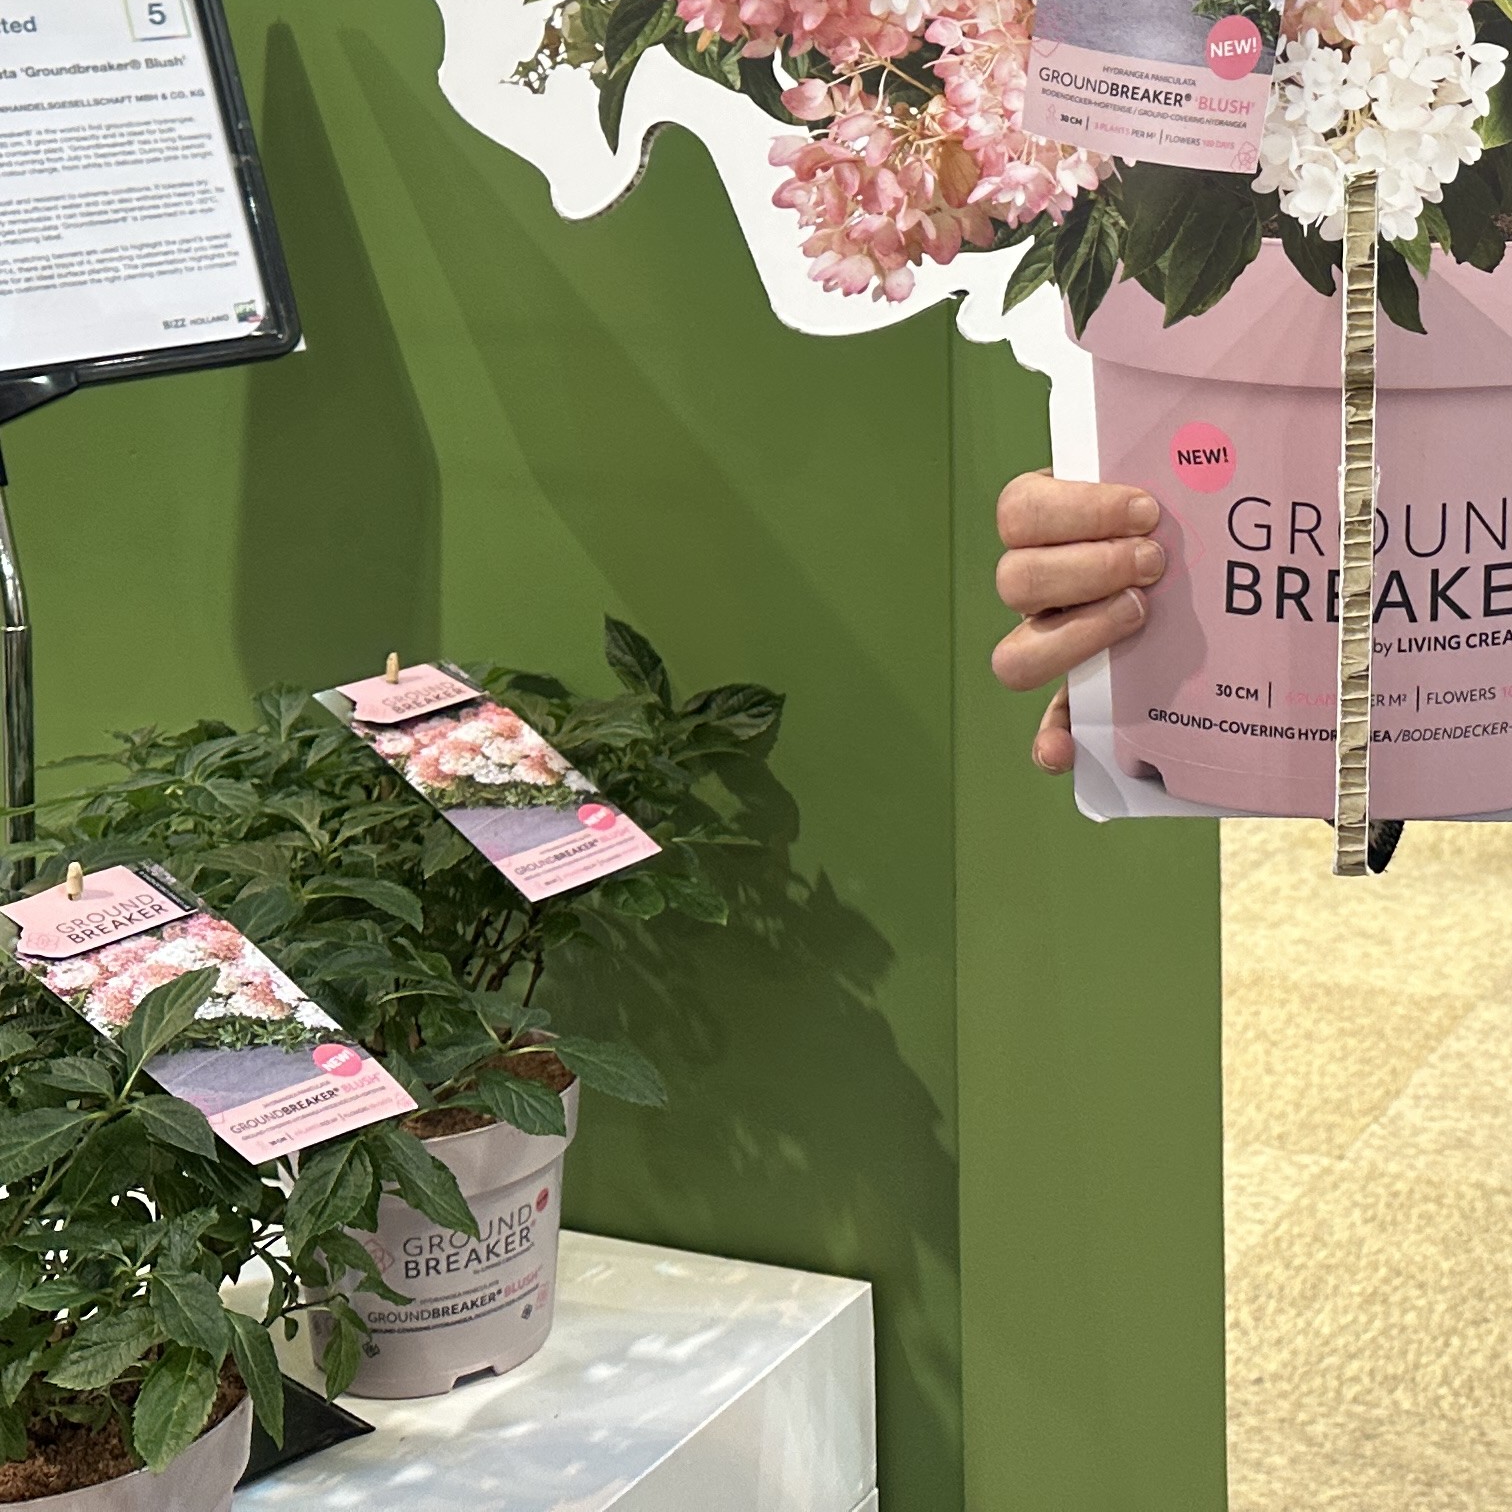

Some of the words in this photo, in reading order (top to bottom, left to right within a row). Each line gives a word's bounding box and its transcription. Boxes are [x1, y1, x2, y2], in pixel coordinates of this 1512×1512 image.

[148, 2, 167, 26] 5
[1210, 37, 1257, 58] NEW!
[1102, 65, 1150, 81] HYDRANGEA
[1165, 134, 1200, 147] FLOWERS
[1177, 446, 1229, 465] NEW!
[1374, 640, 1392, 657] by
[1397, 634, 1461, 653] LIVING
[1215, 684, 1233, 697] 30
[1236, 686, 1258, 700] CM
[1427, 687, 1496, 705] FLOWERS
[1148, 707, 1295, 741] GROUND-COVERING
[56, 893, 155, 934] GROUND
[321, 1047, 356, 1071] NEW!
